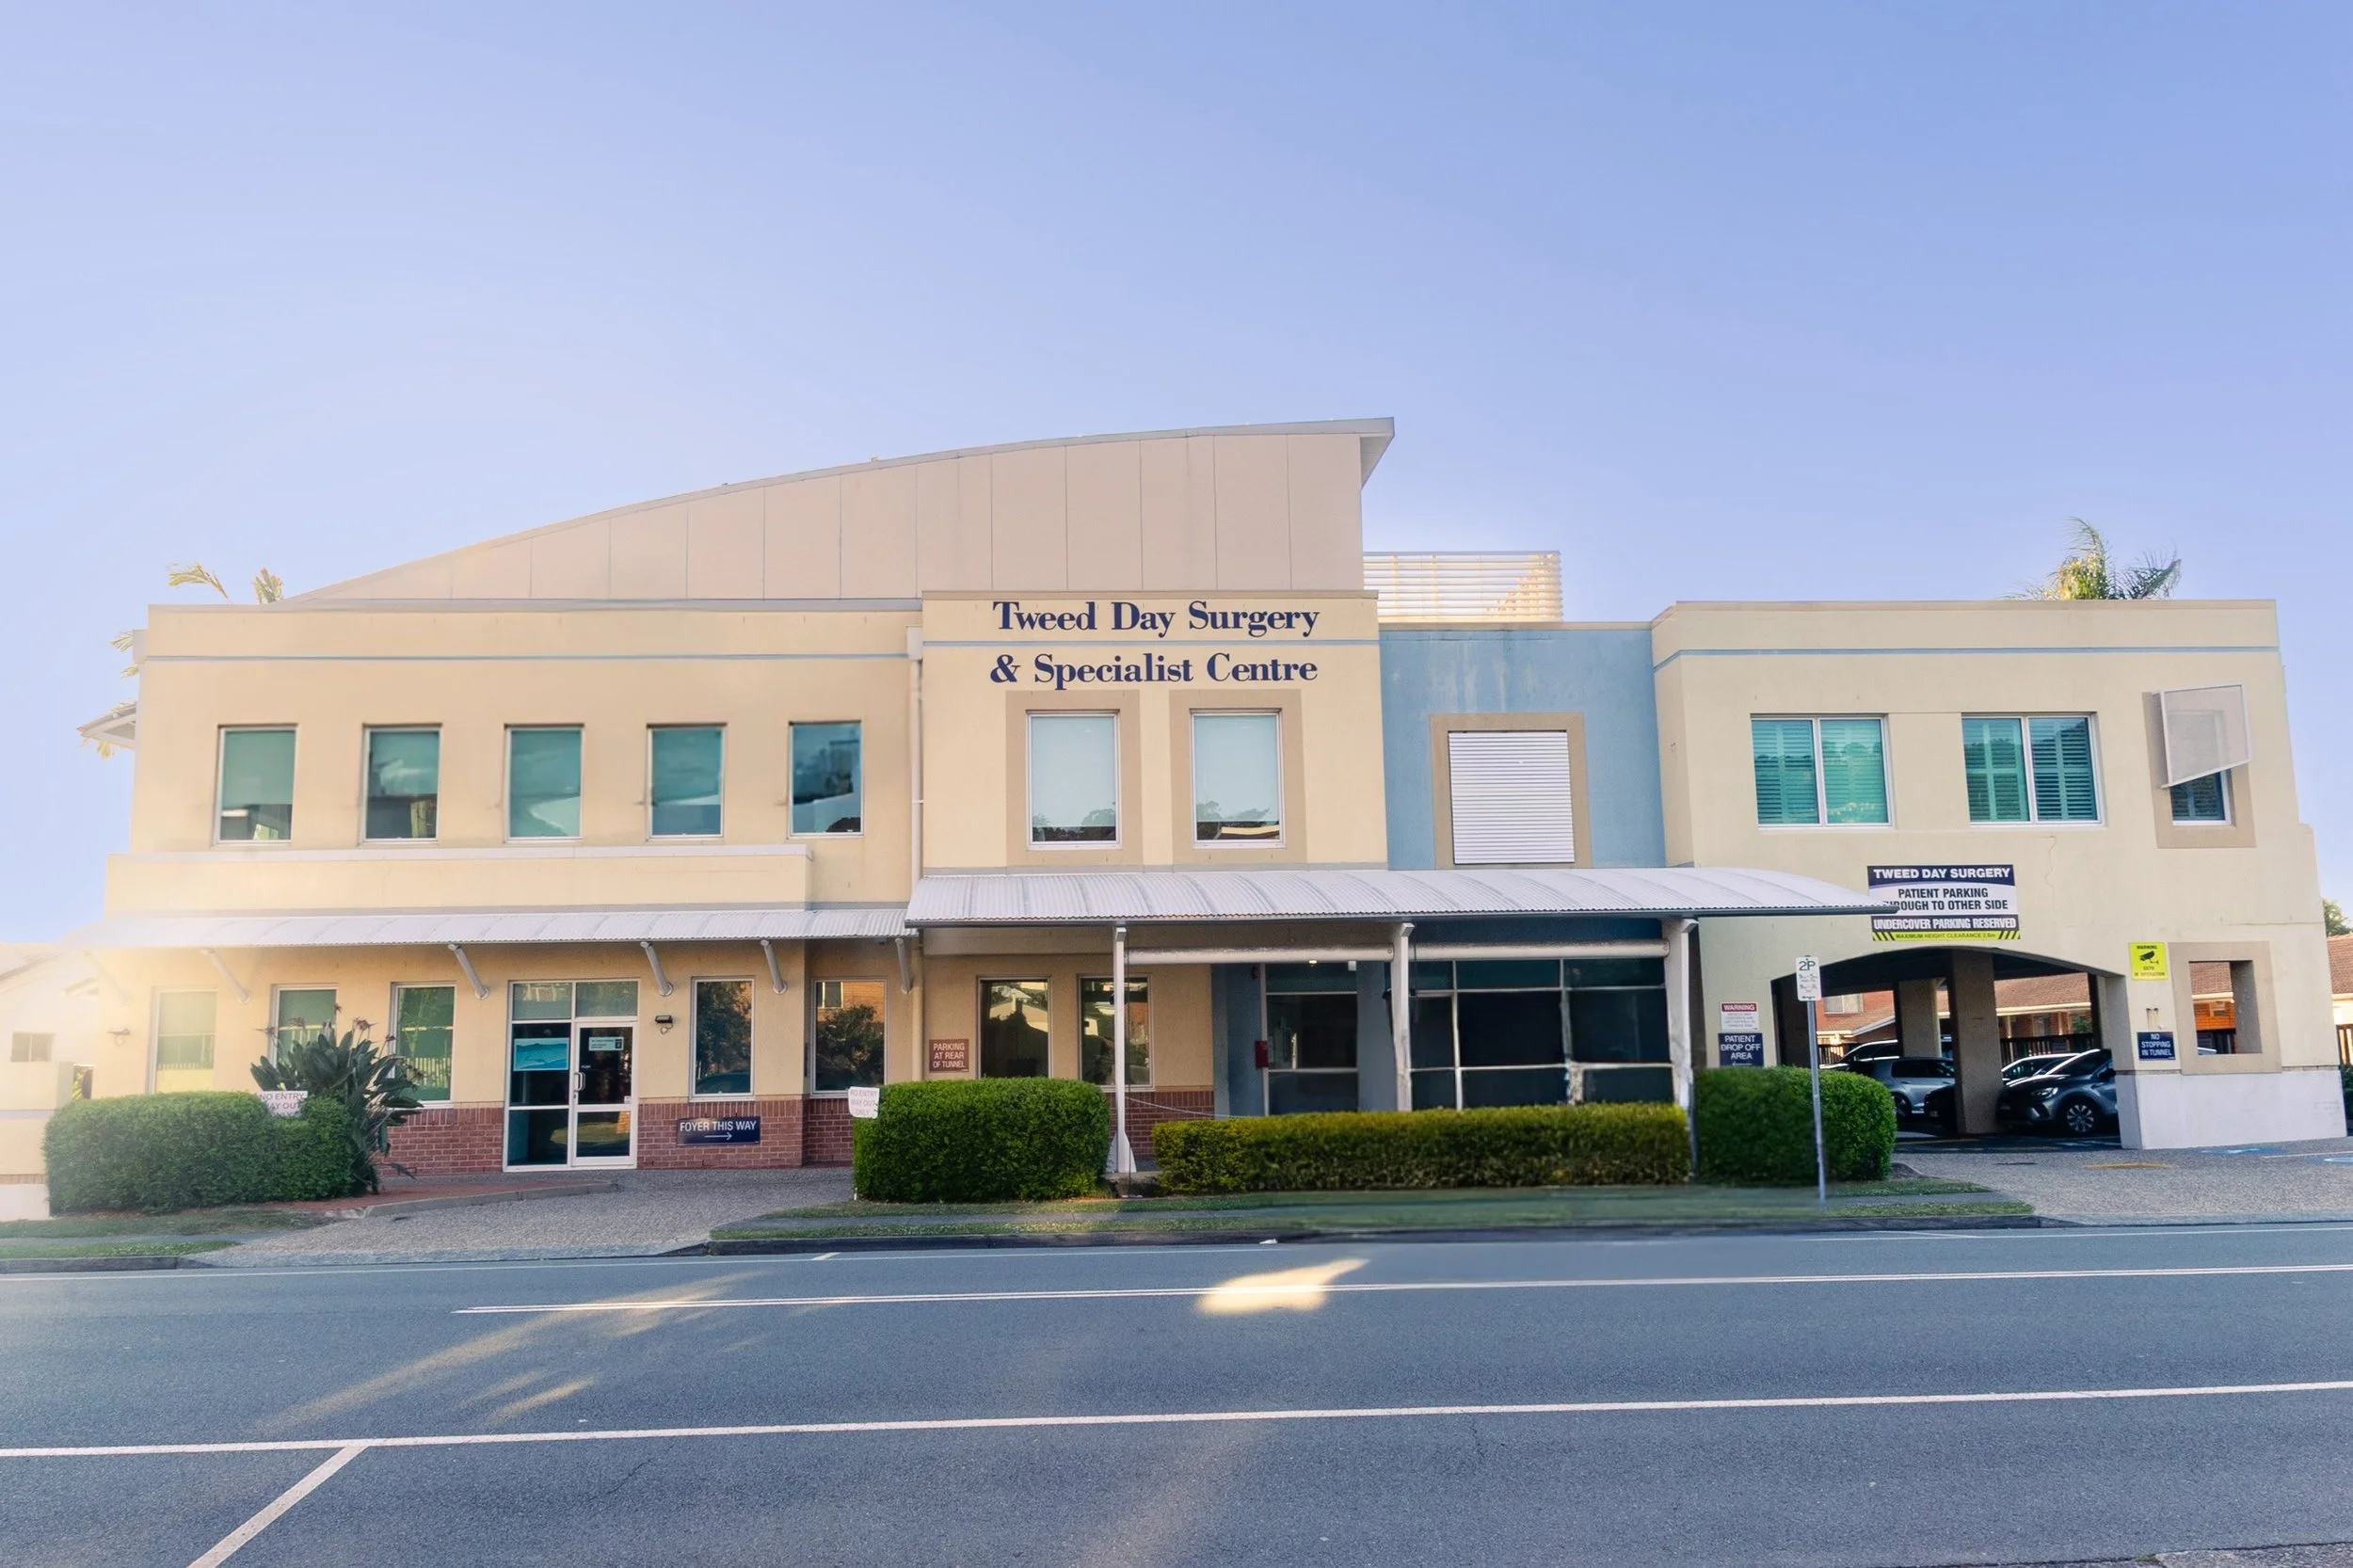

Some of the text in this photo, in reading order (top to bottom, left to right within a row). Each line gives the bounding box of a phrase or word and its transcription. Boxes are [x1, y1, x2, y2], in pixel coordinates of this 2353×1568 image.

[992, 600, 1320, 638] Tweed Day Surgery
[989, 652, 1318, 691] & Specialist Centre
[1873, 868, 2010, 879] TWEED DAY SURGERY
[1897, 888, 1989, 899] PATIENT PARKING
[1931, 900, 1945, 910] TO
[1947, 900, 1981, 910] OTHER
[1984, 899, 2009, 910] SIDE
[1873, 918, 2016, 930] UNDERCOVER PARKING RESERVED
[1799, 960, 1816, 970] 2P
[1745, 1043, 1761, 1051] OFF
[934, 1051, 965, 1060] AT REAR
[942, 1060, 965, 1068] TUNNEL
[680, 1120, 757, 1131] FOYER THIS WAY
